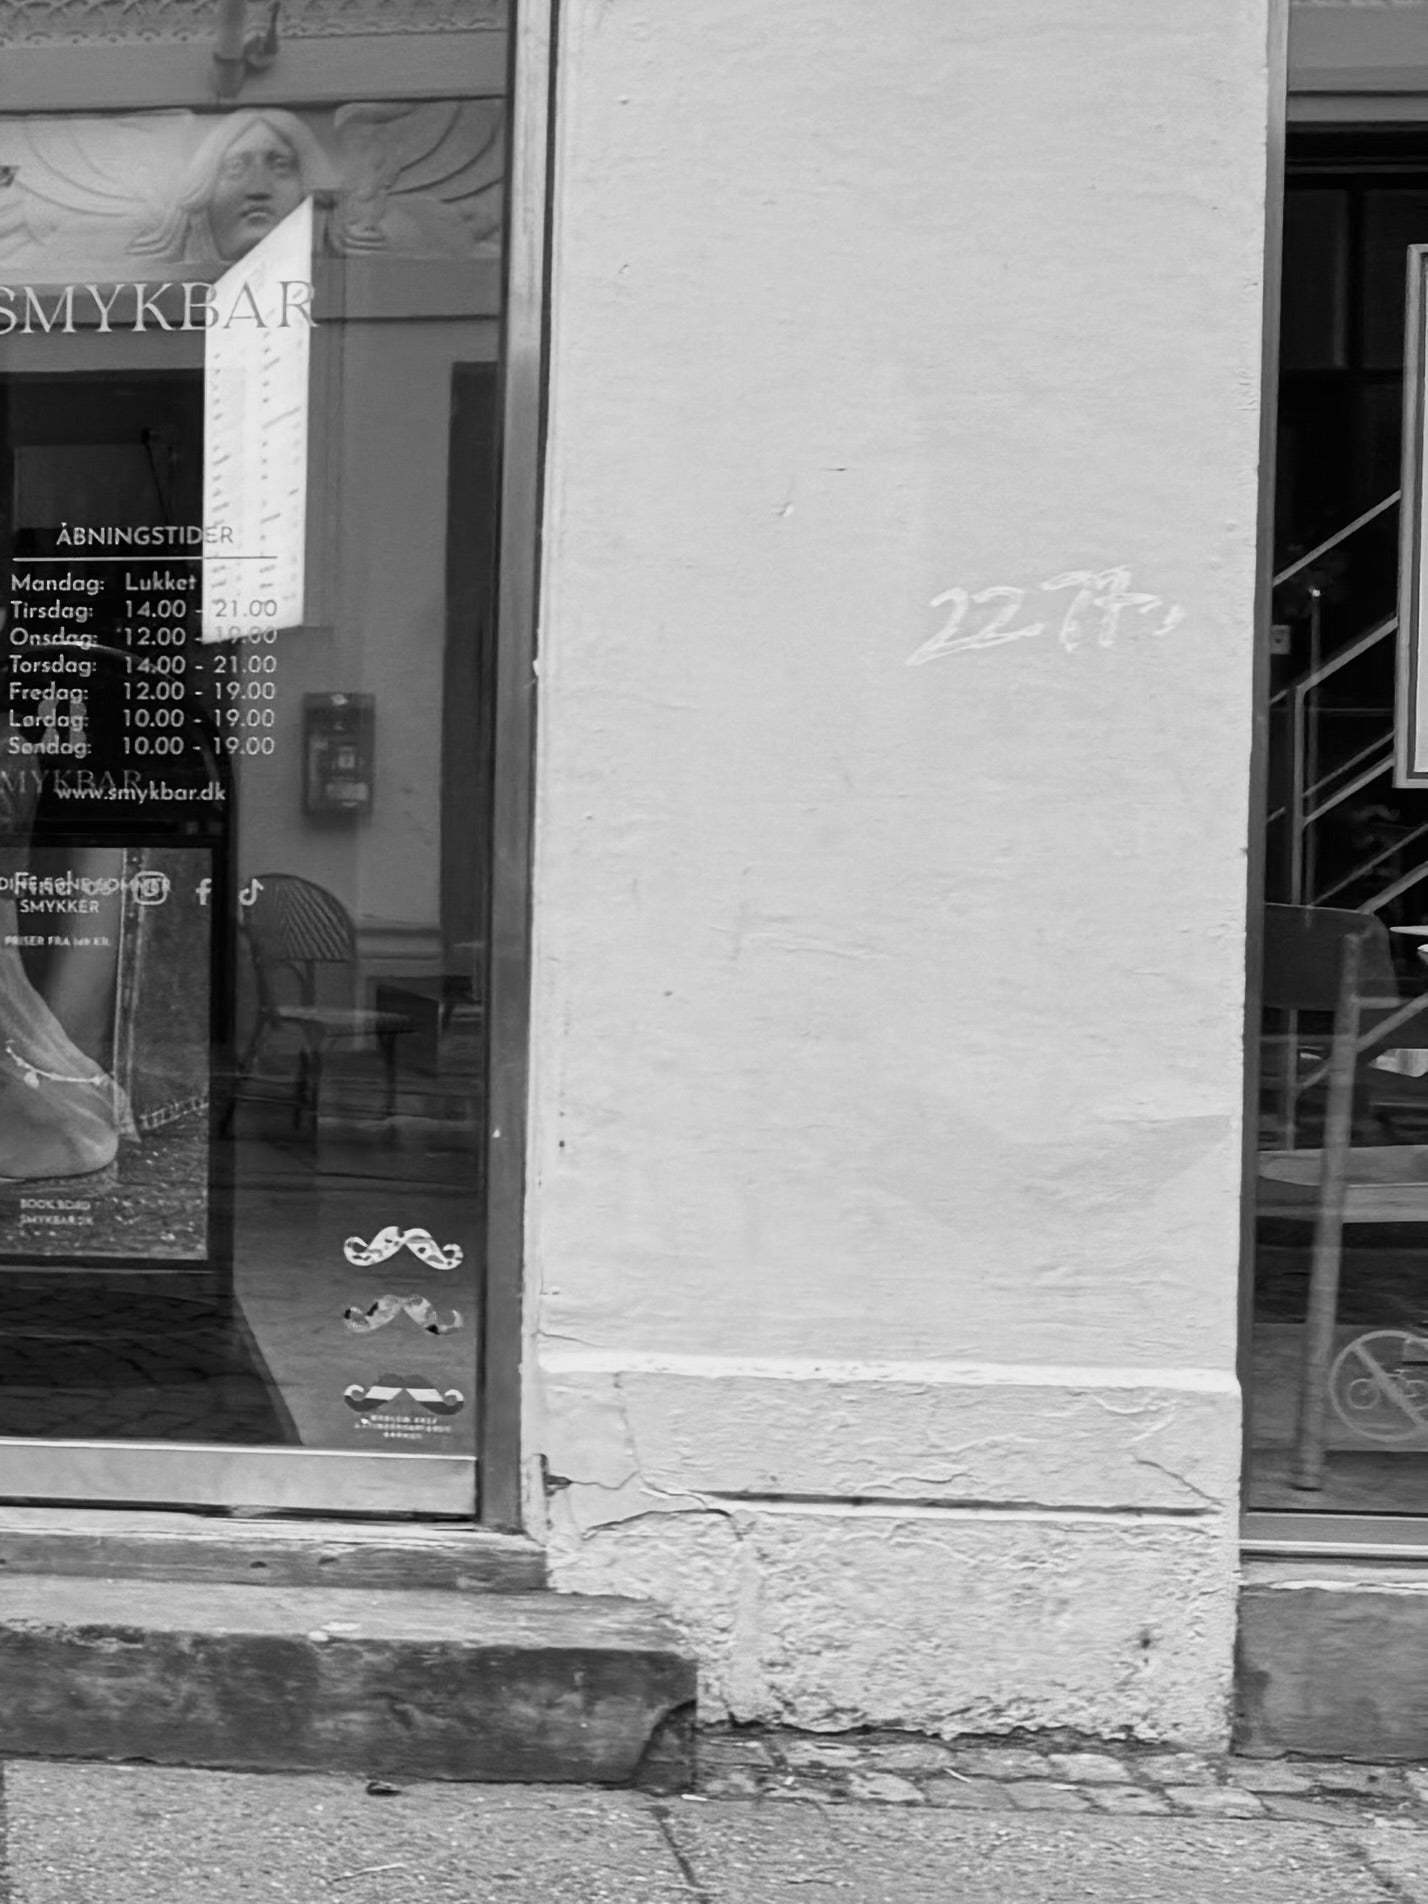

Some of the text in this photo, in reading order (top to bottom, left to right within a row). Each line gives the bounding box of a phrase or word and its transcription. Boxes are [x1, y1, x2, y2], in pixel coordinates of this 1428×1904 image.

[56, 521, 234, 546] ÅBNINGSTIDER
[11, 570, 196, 596] Mandag: Lukket
[10, 599, 93, 623] Tirsdag:
[124, 599, 186, 619] 14.00
[215, 599, 277, 618] 21.00
[9, 627, 97, 649] Onsdag:
[124, 627, 186, 646] 12.00
[9, 654, 97, 678] Torsdag:
[124, 655, 186, 674] 14.00
[213, 655, 277, 674] 21.00
[9, 681, 89, 704] Fredag:
[124, 681, 185, 701] 12.00
[214, 681, 276, 700] 19.00
[9, 708, 89, 729] Lørdag:
[123, 708, 185, 728] 10.00
[214, 708, 276, 728] 19.00
[8, 736, 92, 759] Søndag:
[122, 736, 184, 756] 10.00
[213, 736, 275, 755] 19.00
[55, 780, 227, 804] www.smykbar.dk
[19, 899, 100, 914] SMYKKER
